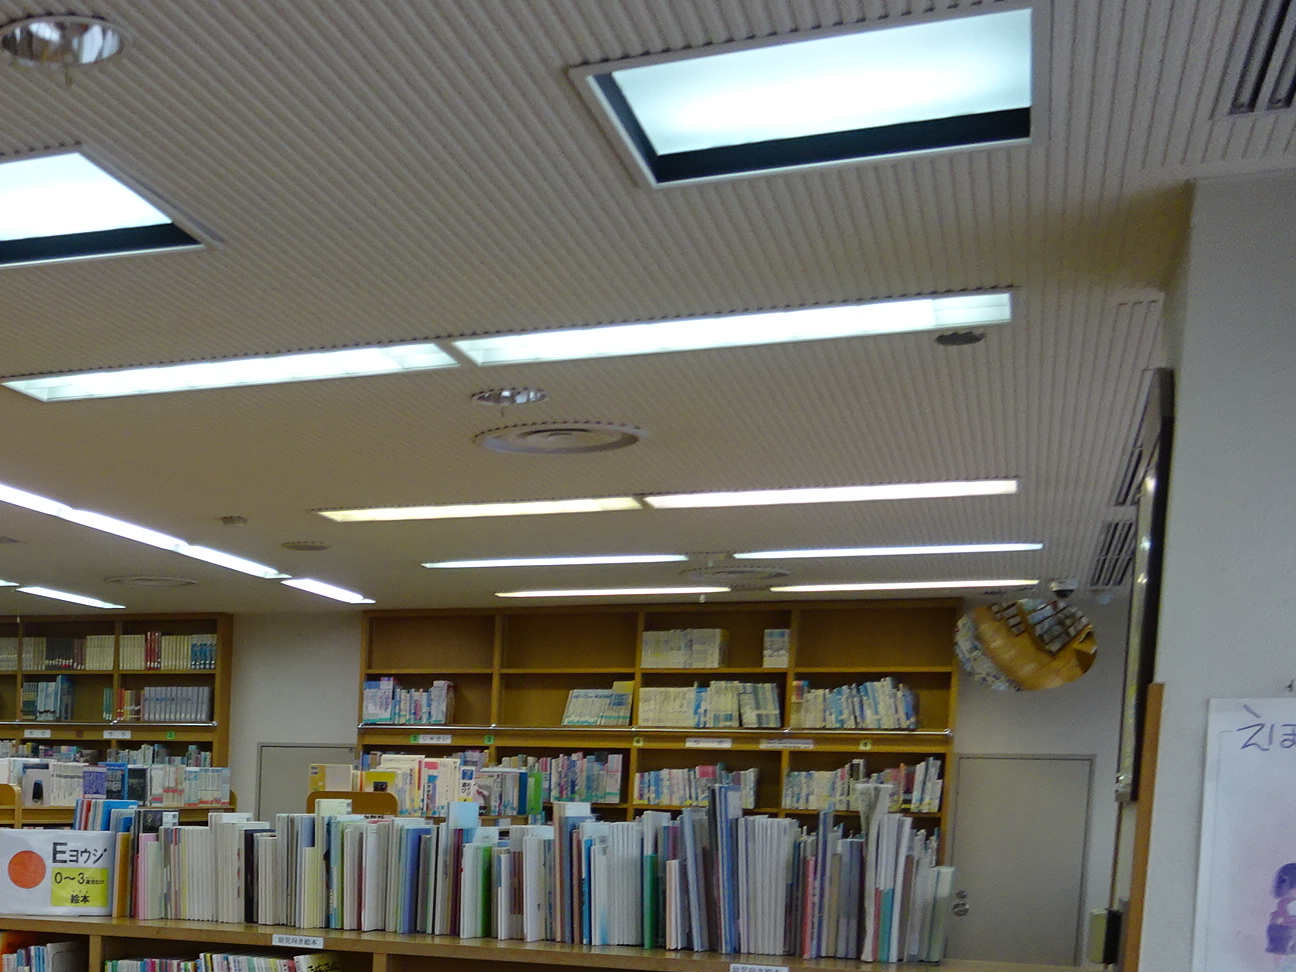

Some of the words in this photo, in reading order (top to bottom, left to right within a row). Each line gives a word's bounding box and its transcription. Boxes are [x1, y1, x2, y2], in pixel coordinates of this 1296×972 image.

[52, 842, 107, 864] Eヨウジ
[70, 894, 90, 904] 絵本
